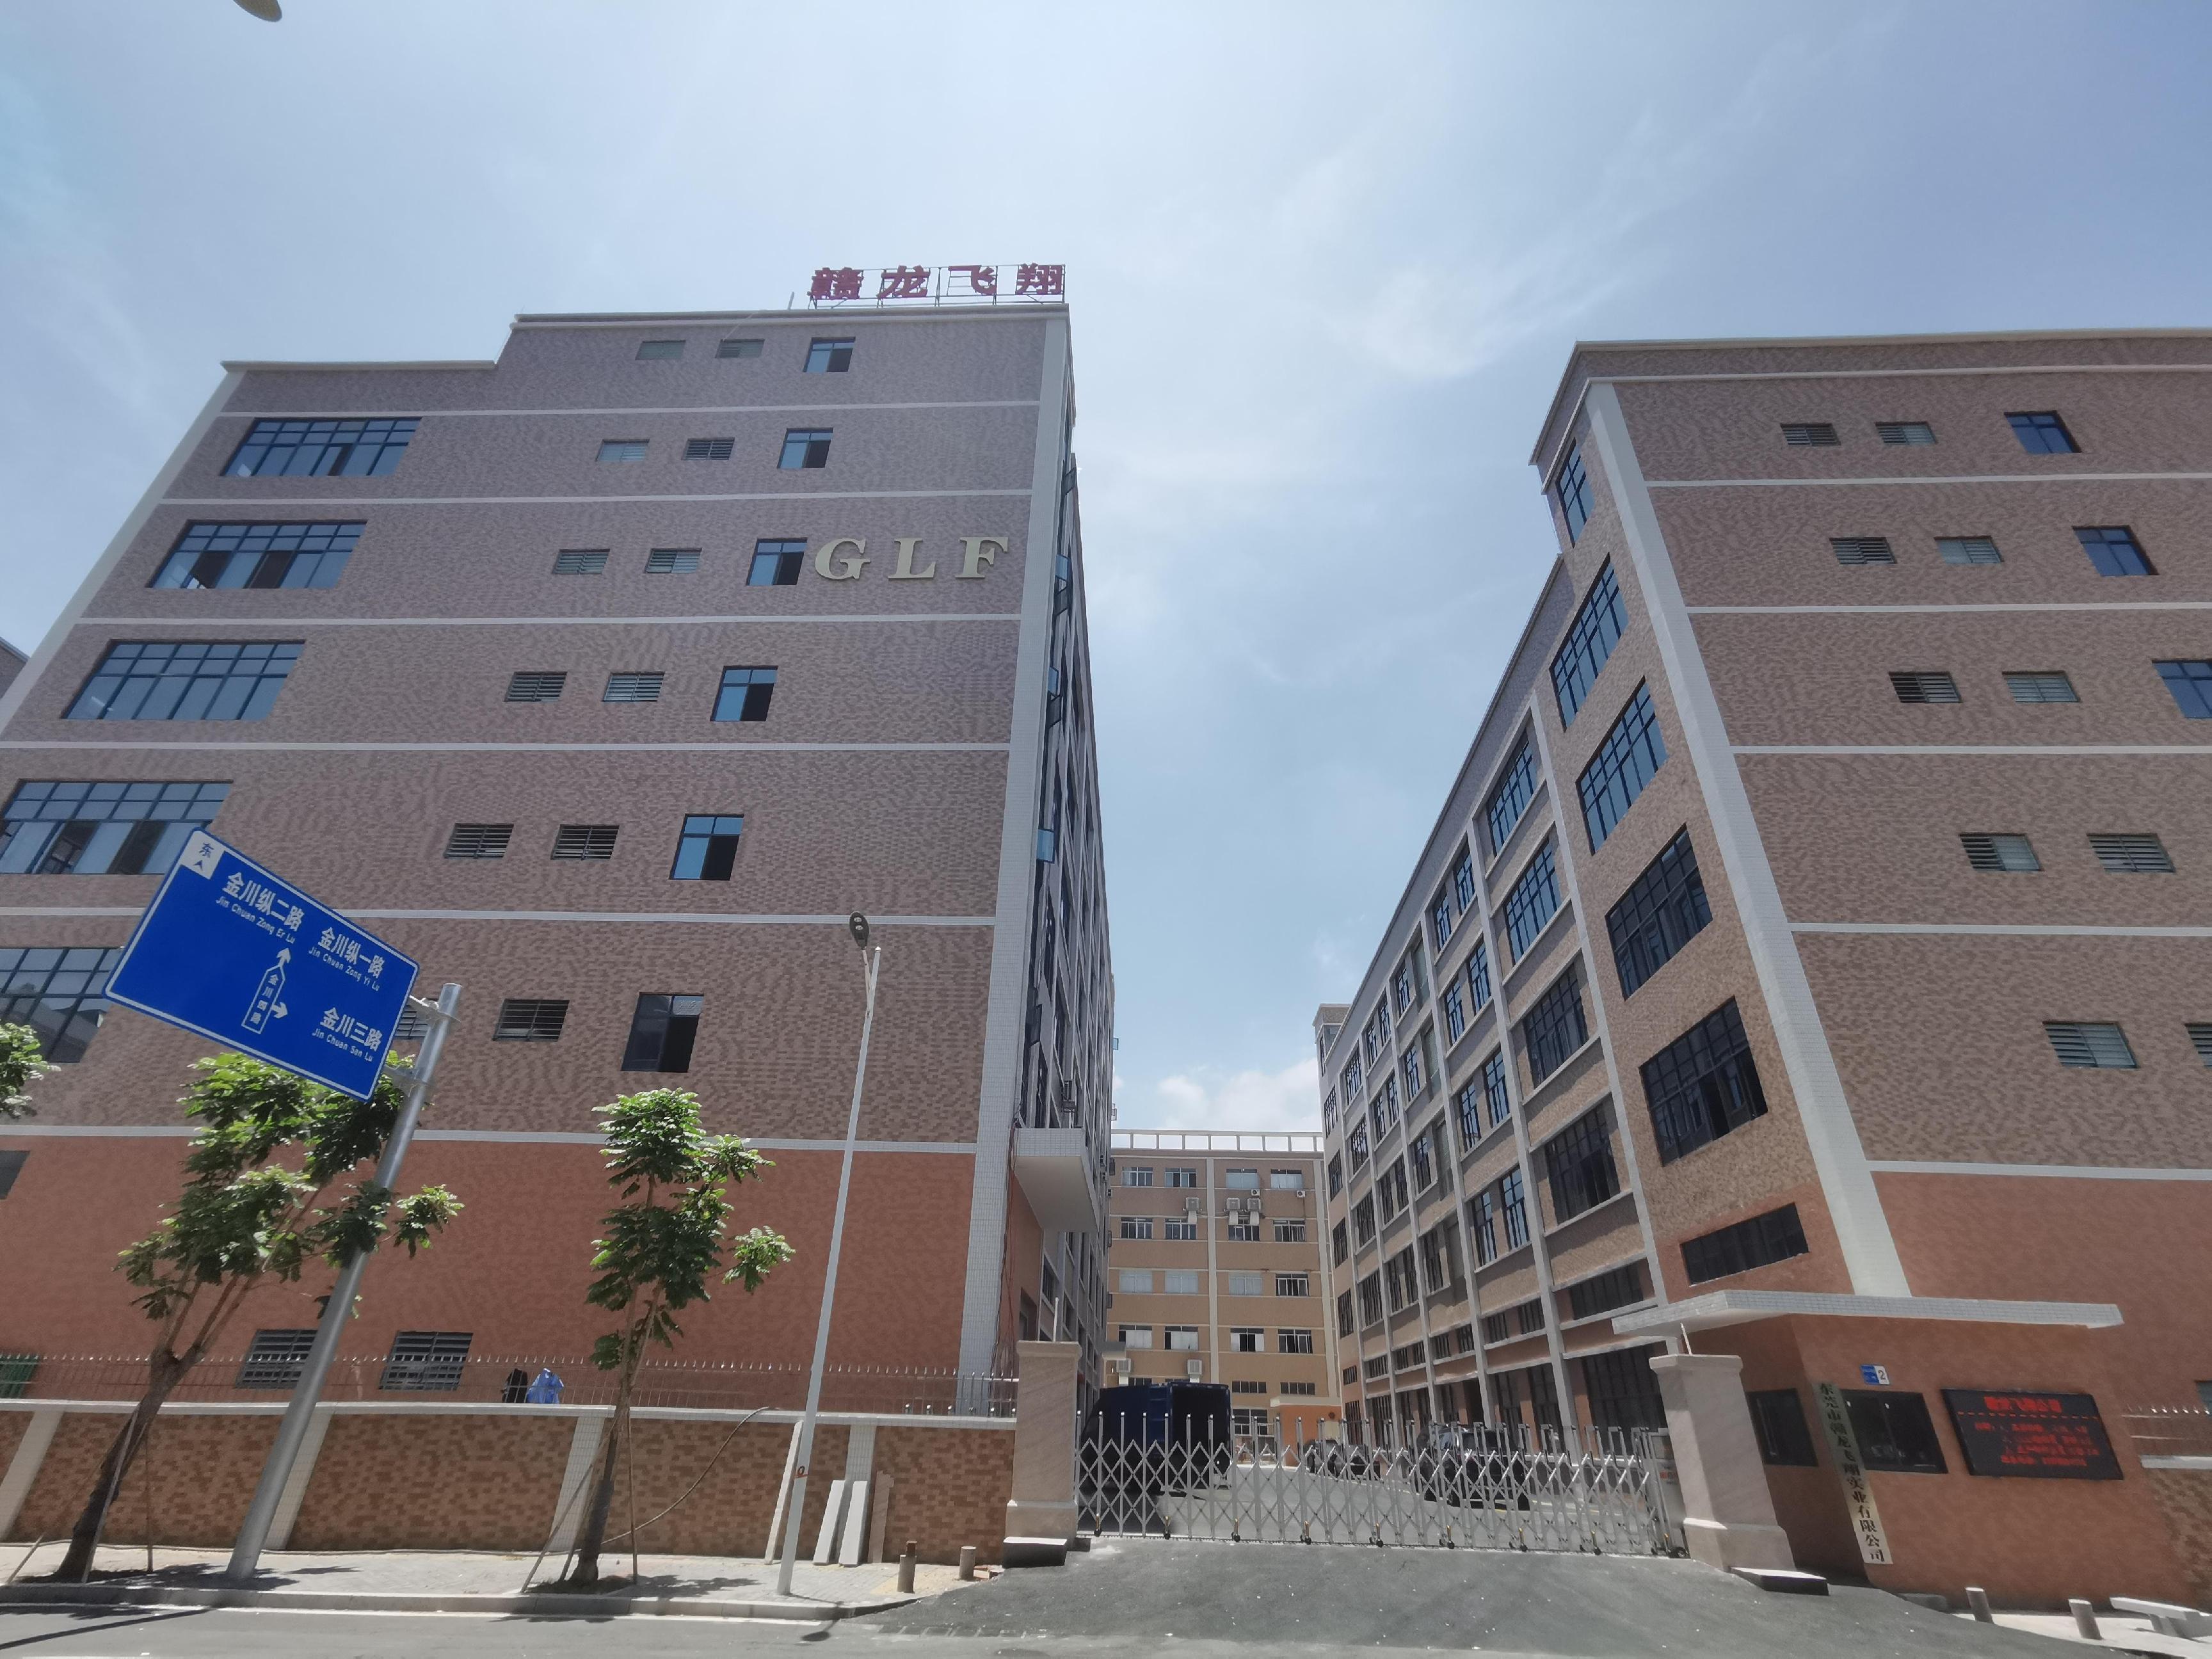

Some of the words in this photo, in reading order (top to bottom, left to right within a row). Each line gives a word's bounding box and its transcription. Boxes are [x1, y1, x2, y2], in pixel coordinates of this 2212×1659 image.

[815, 536, 1009, 579] GLF
[199, 842, 214, 858] 东
[216, 895, 230, 908] Jin
[231, 904, 257, 922] Chuan
[257, 917, 275, 934] Zong
[276, 927, 286, 938] Er
[286, 933, 296, 944] Lu
[222, 871, 305, 931] 金川纵二路
[309, 946, 321, 958] Jin
[323, 953, 344, 970] Chuan
[345, 965, 362, 982] Zong
[364, 975, 371, 987] Yi
[371, 982, 381, 991] Lu
[317, 927, 385, 978] 金川纵一路
[250, 974, 278, 1025] 金川四路
[312, 1028, 325, 1039] Jin
[326, 1034, 348, 1050] Chuan
[350, 1045, 363, 1057] San
[364, 1052, 374, 1062] Lu
[320, 1007, 382, 1052] 金川三路
[1878, 1370, 1886, 1380] 2
